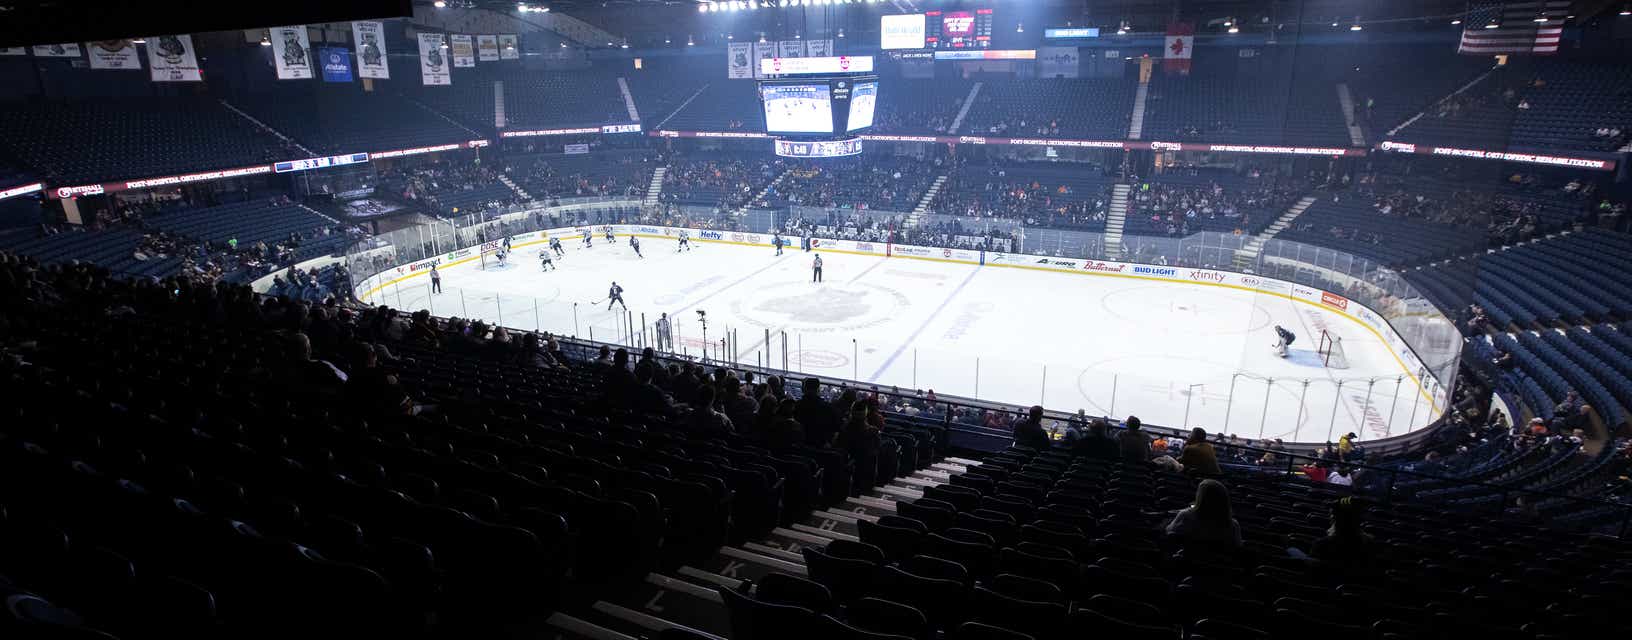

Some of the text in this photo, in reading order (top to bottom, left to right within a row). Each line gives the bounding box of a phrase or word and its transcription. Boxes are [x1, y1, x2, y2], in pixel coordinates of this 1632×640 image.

[1434, 147, 1485, 158] POST-HOSPITAL
[127, 176, 180, 188] POST-HOSPITAL
[180, 172, 222, 182] ORTHOPEDIC
[701, 231, 721, 240] Hefty
[1084, 261, 1126, 273] Butternut
[1154, 268, 1176, 276] LIGHT
[1190, 270, 1225, 283] xfinity
[820, 519, 838, 530] H
